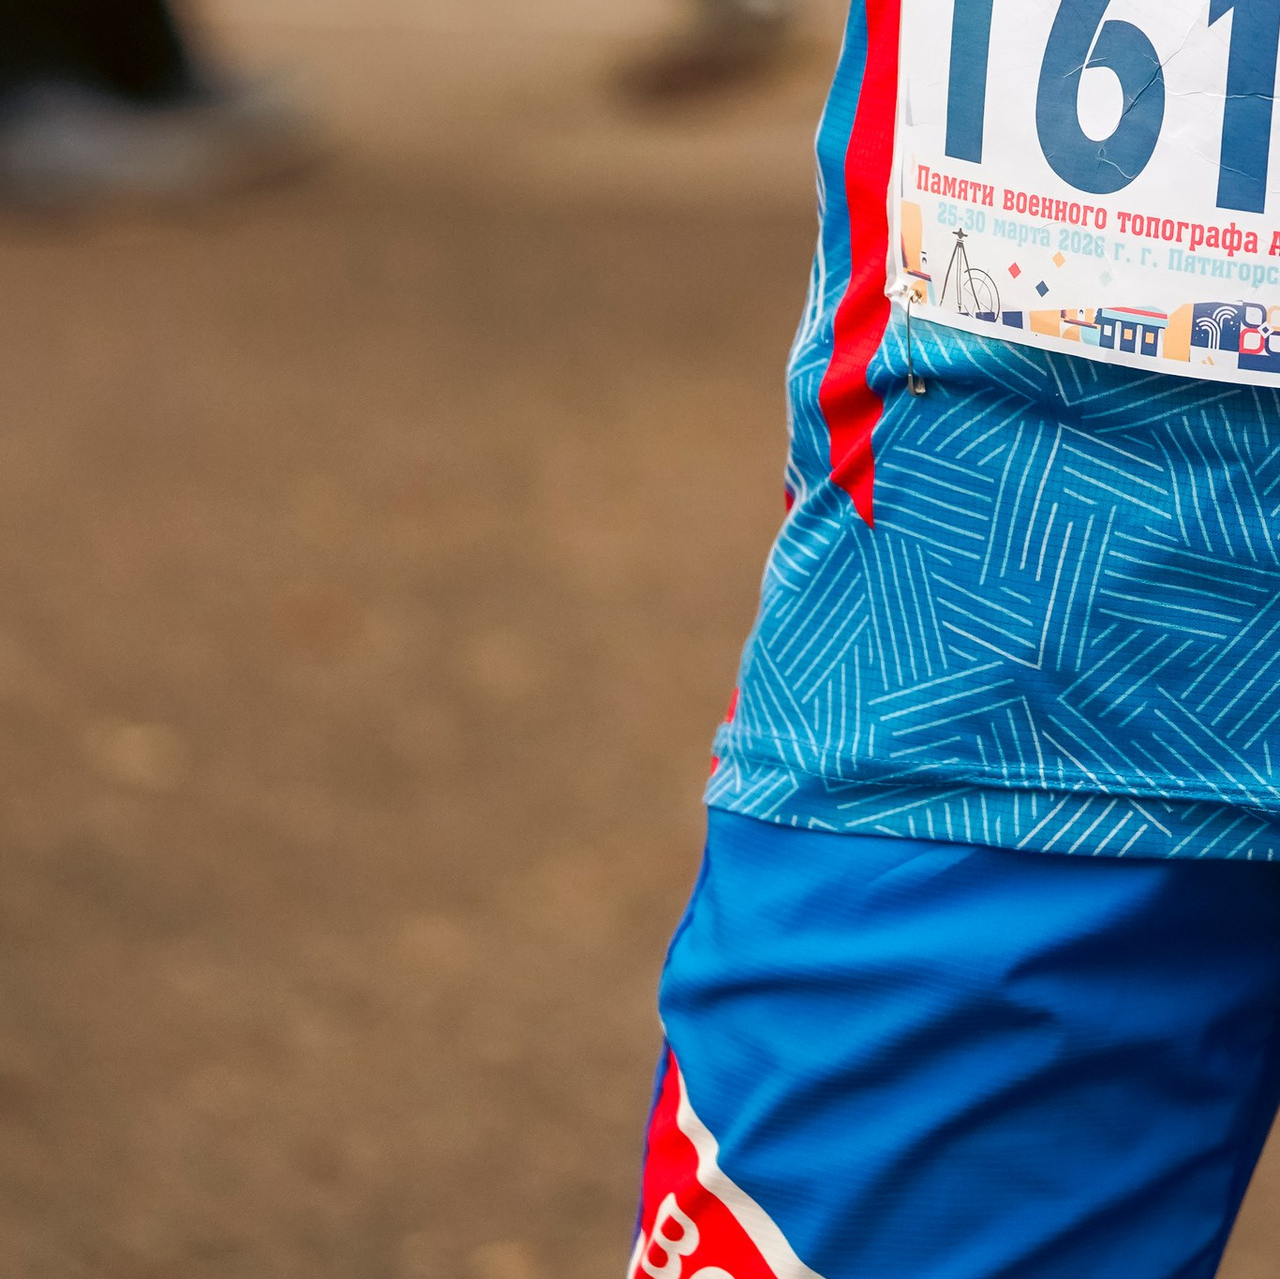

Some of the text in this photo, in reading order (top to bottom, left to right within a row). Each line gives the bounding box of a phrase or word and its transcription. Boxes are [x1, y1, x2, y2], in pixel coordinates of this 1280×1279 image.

[916, 164, 995, 208] Памяти
[1002, 188, 1108, 230] военного
[1116, 210, 1258, 257] топографа
[936, 201, 987, 234] 25-30
[992, 217, 1052, 249] марта
[1057, 228, 1107, 259] 2026
[1114, 243, 1131, 264] г.
[1140, 247, 1158, 268] г.
